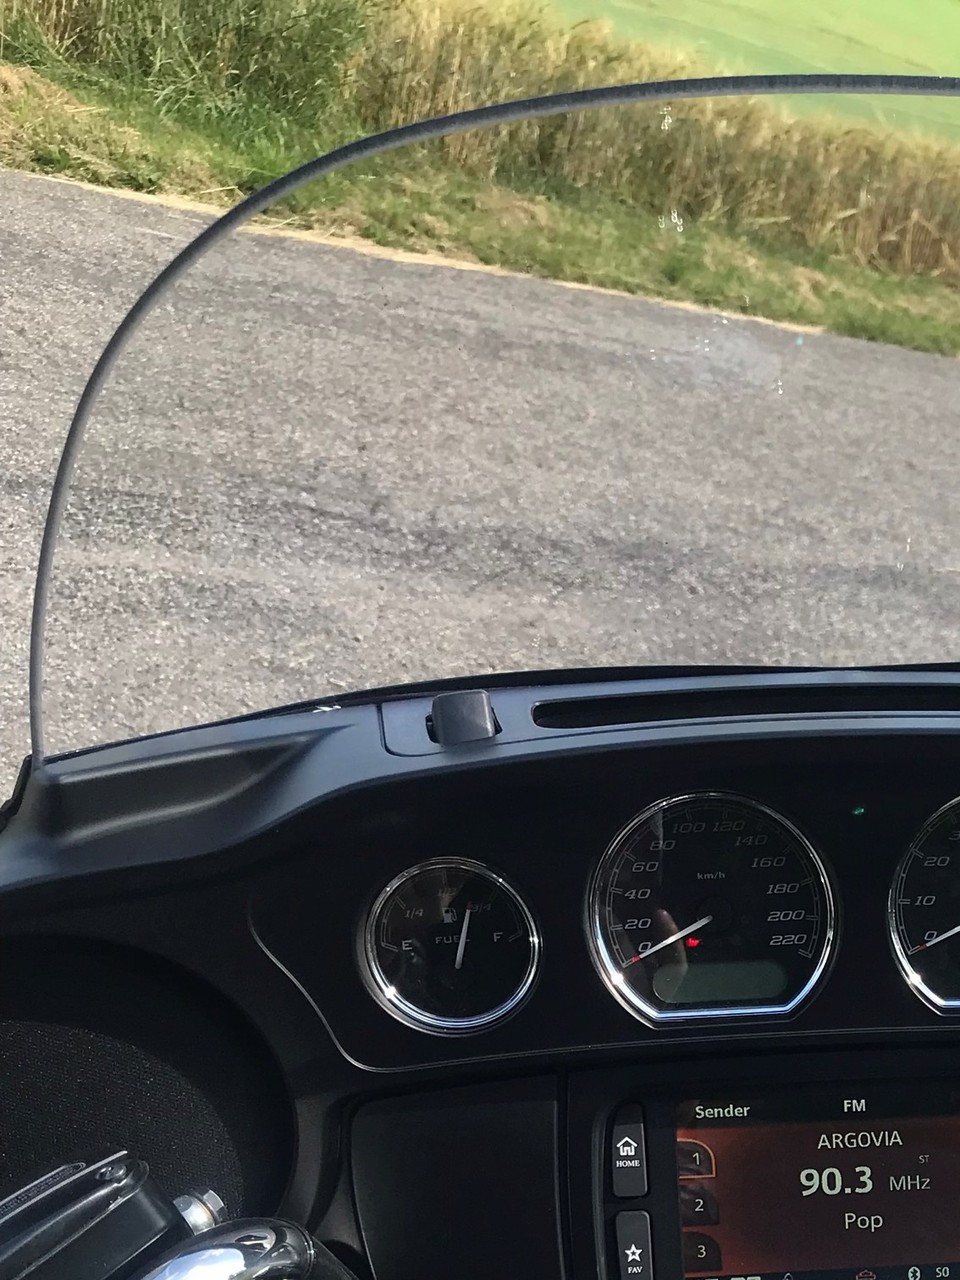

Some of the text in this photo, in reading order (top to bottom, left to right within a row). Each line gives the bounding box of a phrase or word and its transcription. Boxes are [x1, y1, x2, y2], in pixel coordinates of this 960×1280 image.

[672, 823, 705, 834] 100
[712, 821, 745, 832] 120
[650, 840, 676, 851] 80
[735, 835, 768, 846] 140
[632, 862, 658, 872] 60
[751, 857, 786, 868] 160
[924, 857, 950, 867] 20
[697, 872, 726, 881] km/h
[624, 889, 650, 899] 40
[766, 884, 799, 895] 180
[914, 896, 936, 906] 10
[405, 908, 424, 919] 1/4
[767, 910, 805, 922] 200
[624, 919, 651, 930] 20
[493, 932, 503, 942] F
[769, 934, 808, 946] 220
[924, 931, 938, 941] 0
[402, 940, 413, 951] E
[638, 942, 651, 953] 0
[843, 1099, 867, 1112] FM
[695, 1104, 751, 1119] Sender
[817, 1130, 903, 1149] ARGOVIA
[616, 1159, 641, 1168] HOME
[692, 1152, 700, 1165] 1
[918, 1154, 930, 1164] ST
[800, 1165, 931, 1197] 90.3 MHz
[694, 1199, 704, 1212] 2
[844, 1212, 884, 1232] Pop
[697, 1245, 707, 1258] 3
[627, 1266, 643, 1274] FAV
